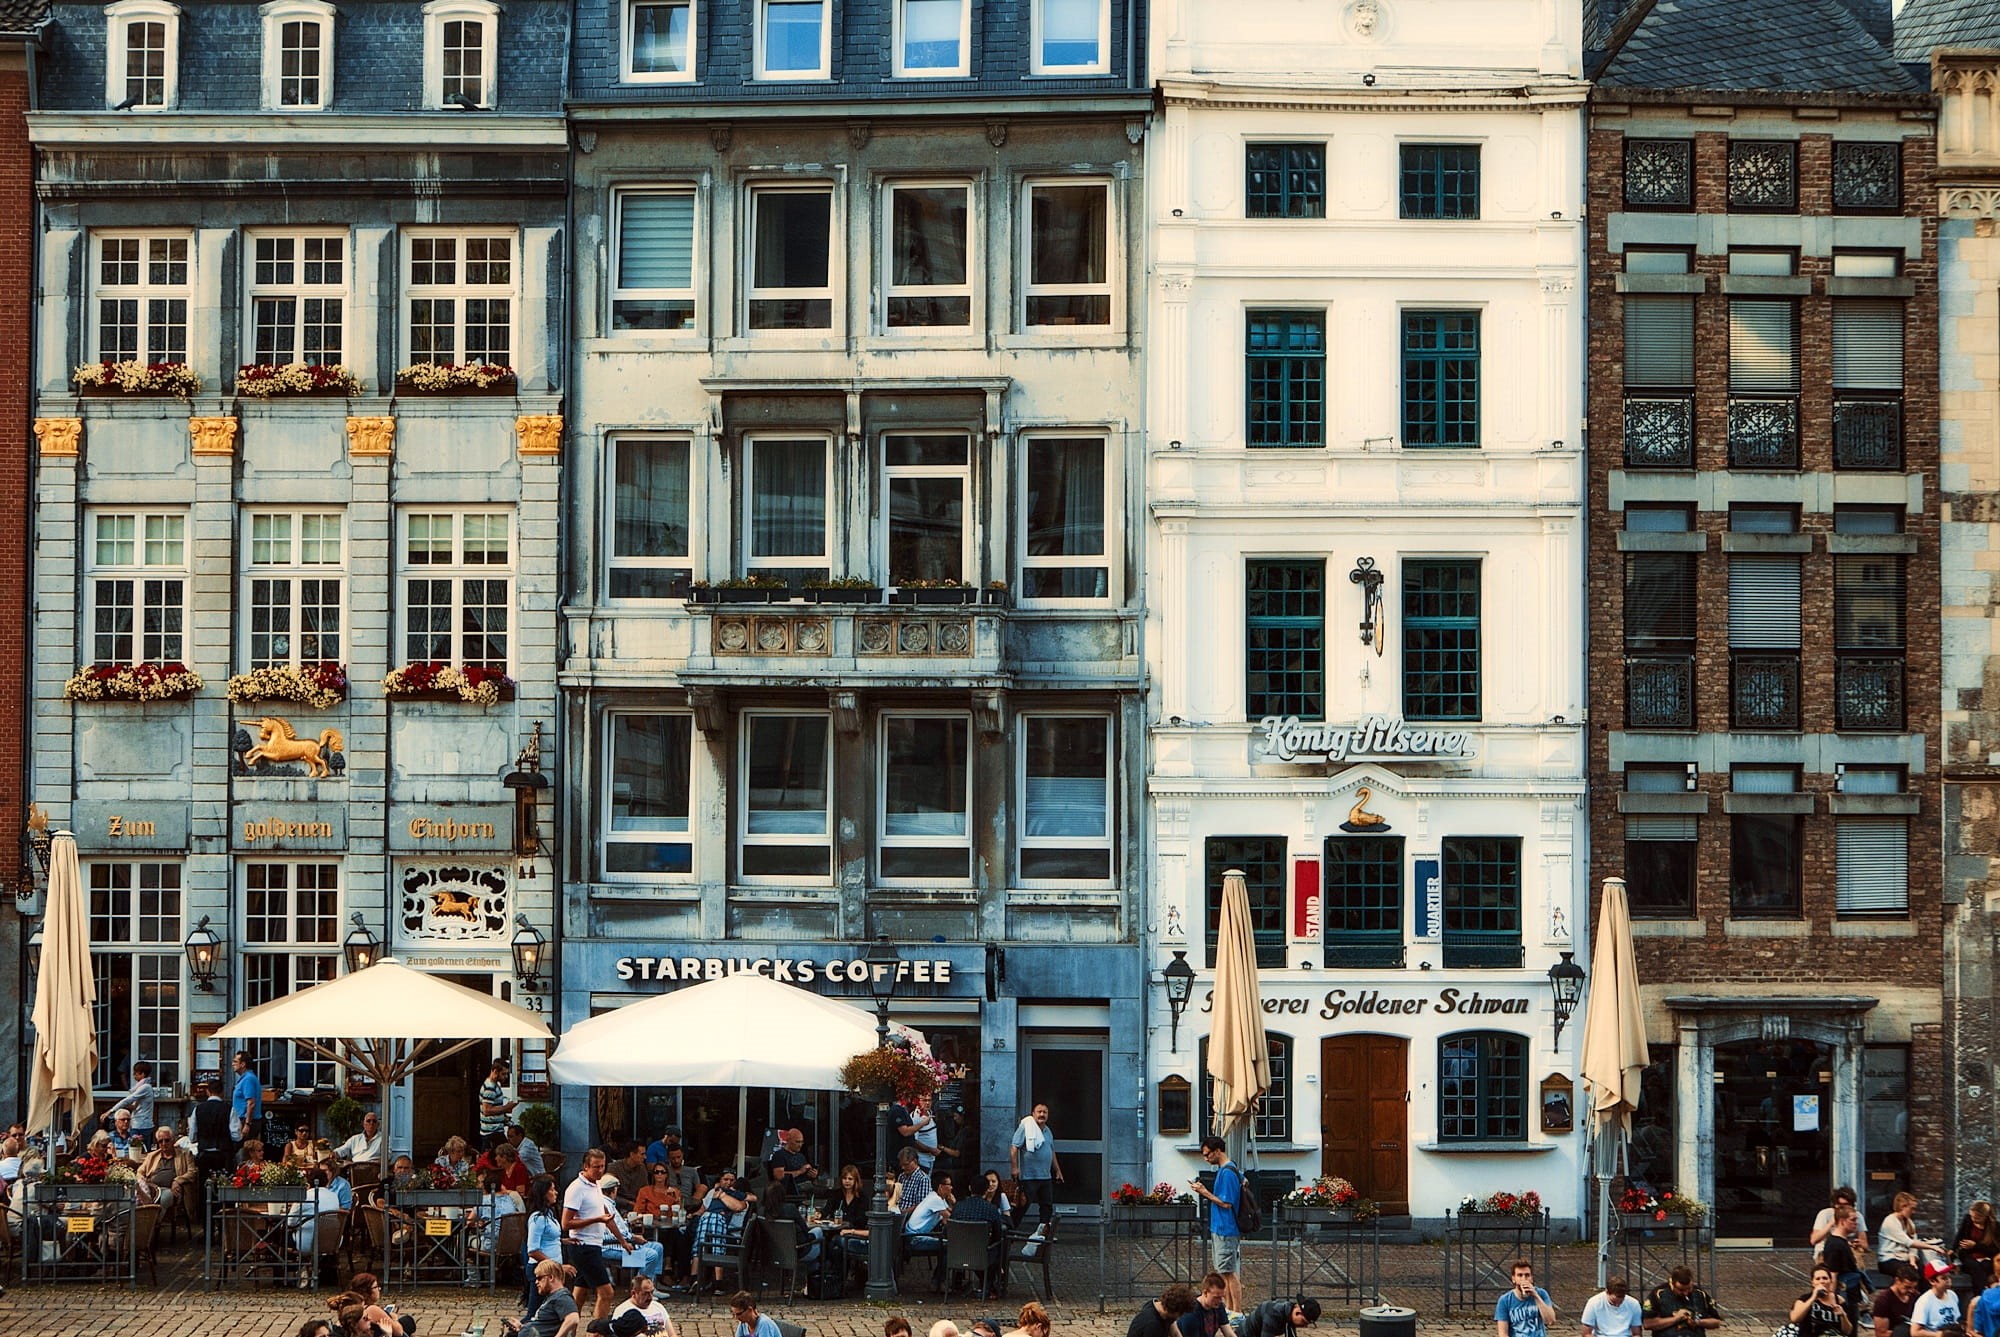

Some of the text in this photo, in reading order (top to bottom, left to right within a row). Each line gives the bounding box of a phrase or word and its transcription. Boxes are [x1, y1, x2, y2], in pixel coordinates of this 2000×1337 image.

[108, 815, 495, 842] Zum goldenen Einhorn
[1306, 896, 1320, 938] STAND
[1426, 877, 1440, 937] QUARTIER
[406, 956, 501, 967] Zum goldenen Einhorn
[825, 959, 950, 983] COFFEE
[525, 997, 543, 1011] 33
[1320, 989, 1428, 1020] Goldener
[1434, 987, 1529, 1015] Schwan
